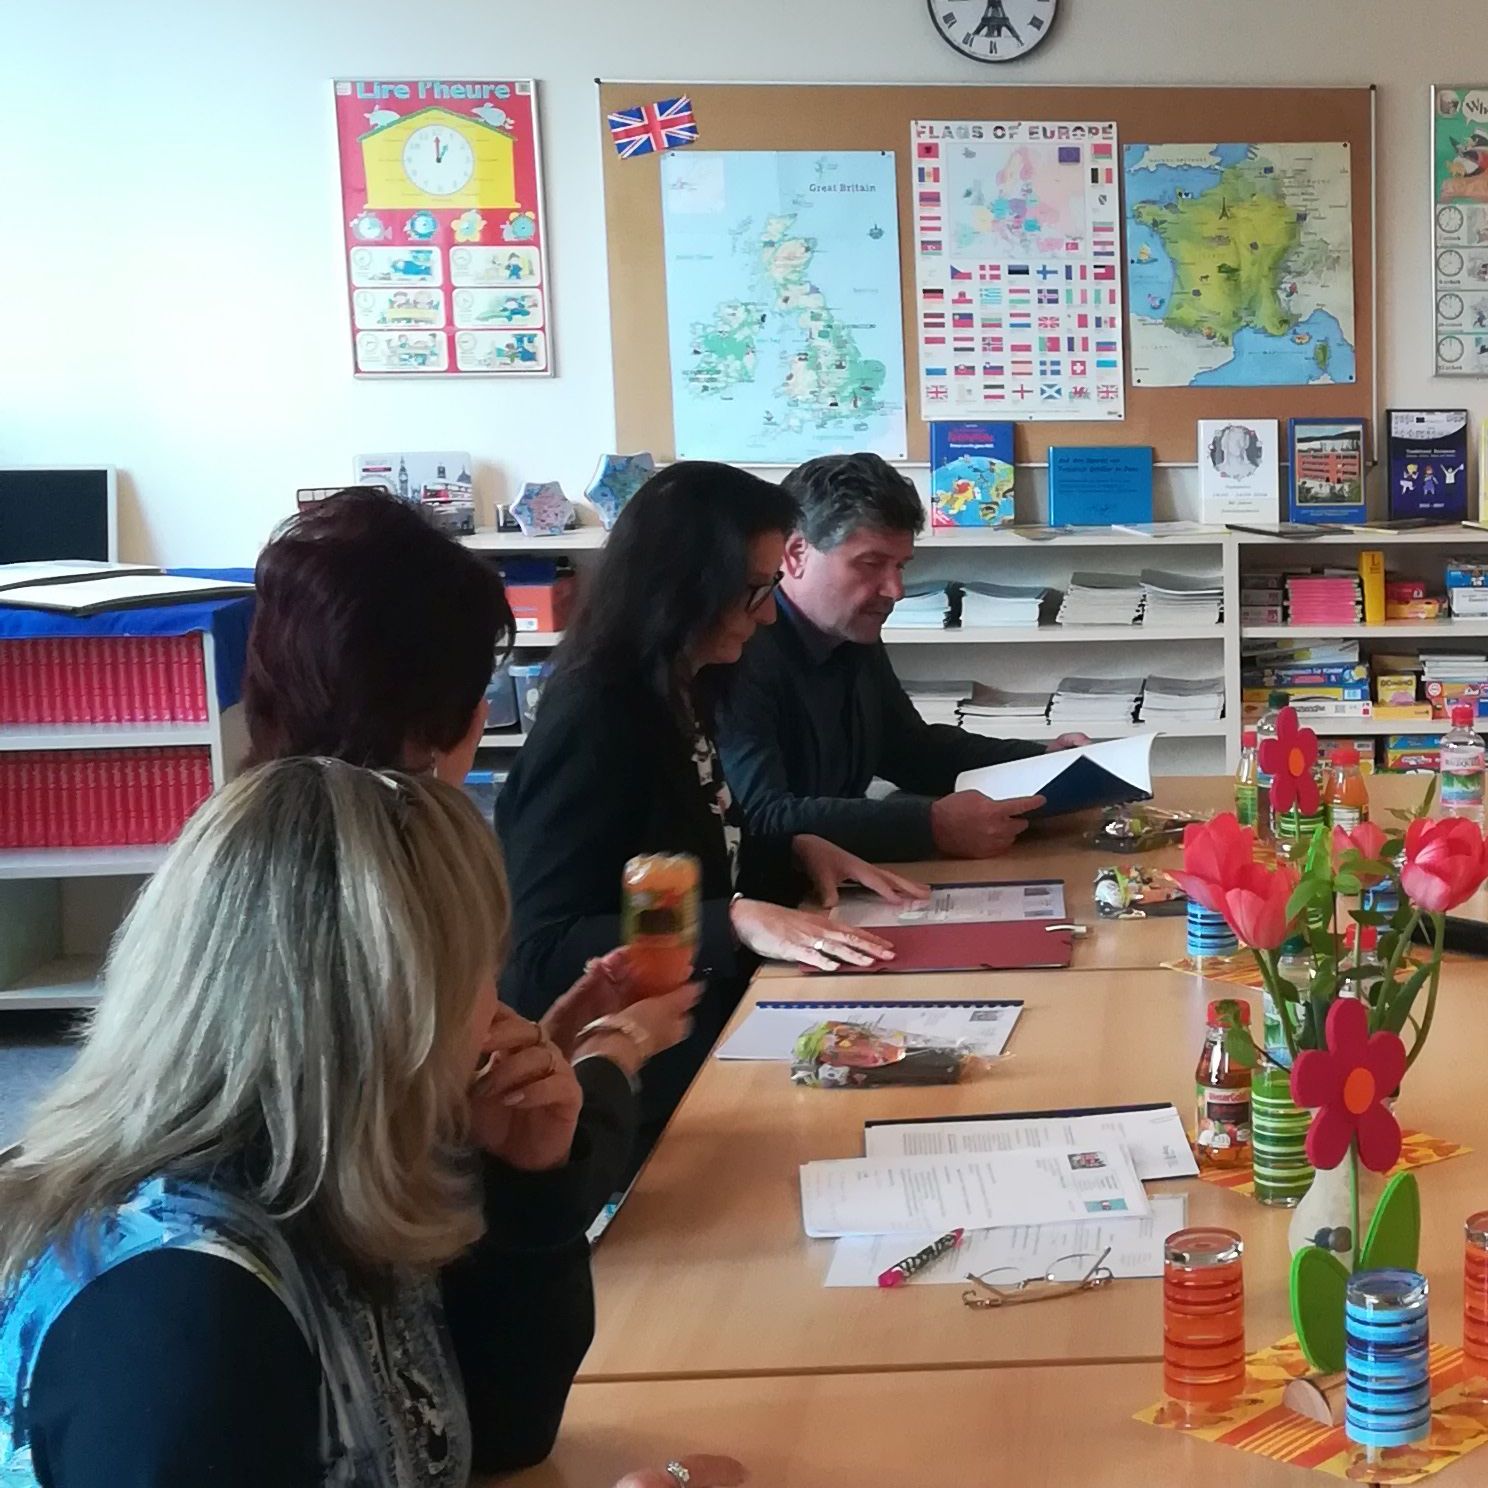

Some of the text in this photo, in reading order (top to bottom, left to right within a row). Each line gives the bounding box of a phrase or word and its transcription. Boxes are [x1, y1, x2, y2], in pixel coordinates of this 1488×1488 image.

[356, 81, 510, 99] Lire l'heure
[916, 125, 1113, 140] FLAGS OF EUROPE
[809, 183, 876, 193] Great Britain
